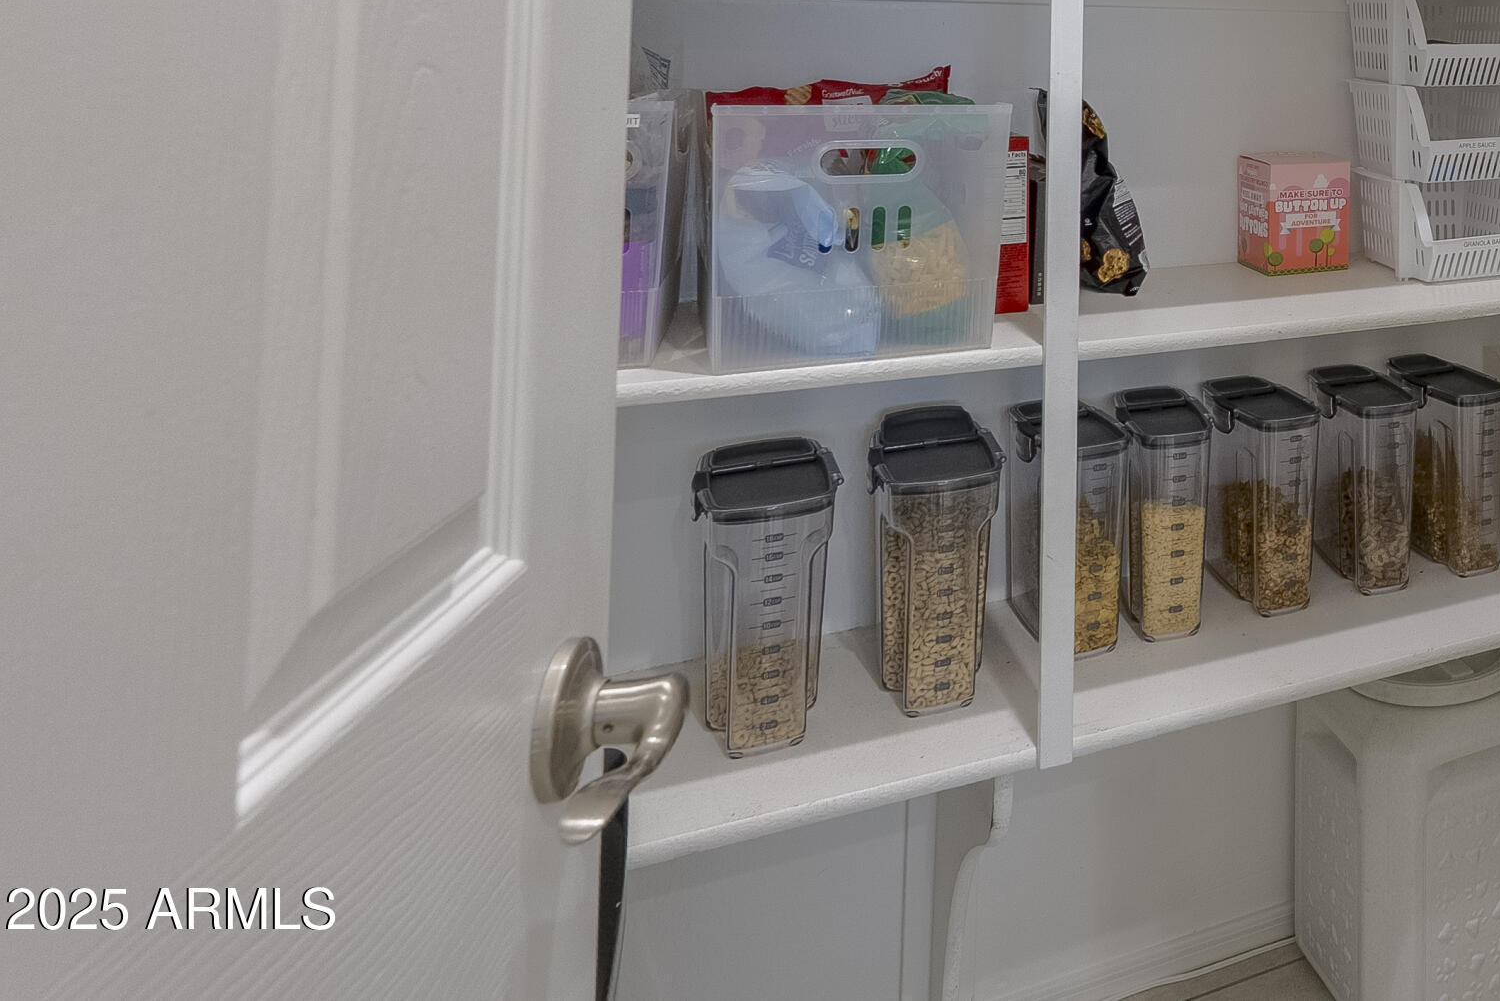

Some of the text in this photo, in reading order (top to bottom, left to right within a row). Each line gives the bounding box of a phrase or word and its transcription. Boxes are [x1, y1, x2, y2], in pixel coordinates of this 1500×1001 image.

[1307, 190, 1329, 198] SURE
[1275, 199, 1328, 213] BUTTON
[1330, 198, 1347, 210] UP
[1291, 219, 1331, 227] ADVENTURE
[1464, 239, 1490, 247] GRANOLA
